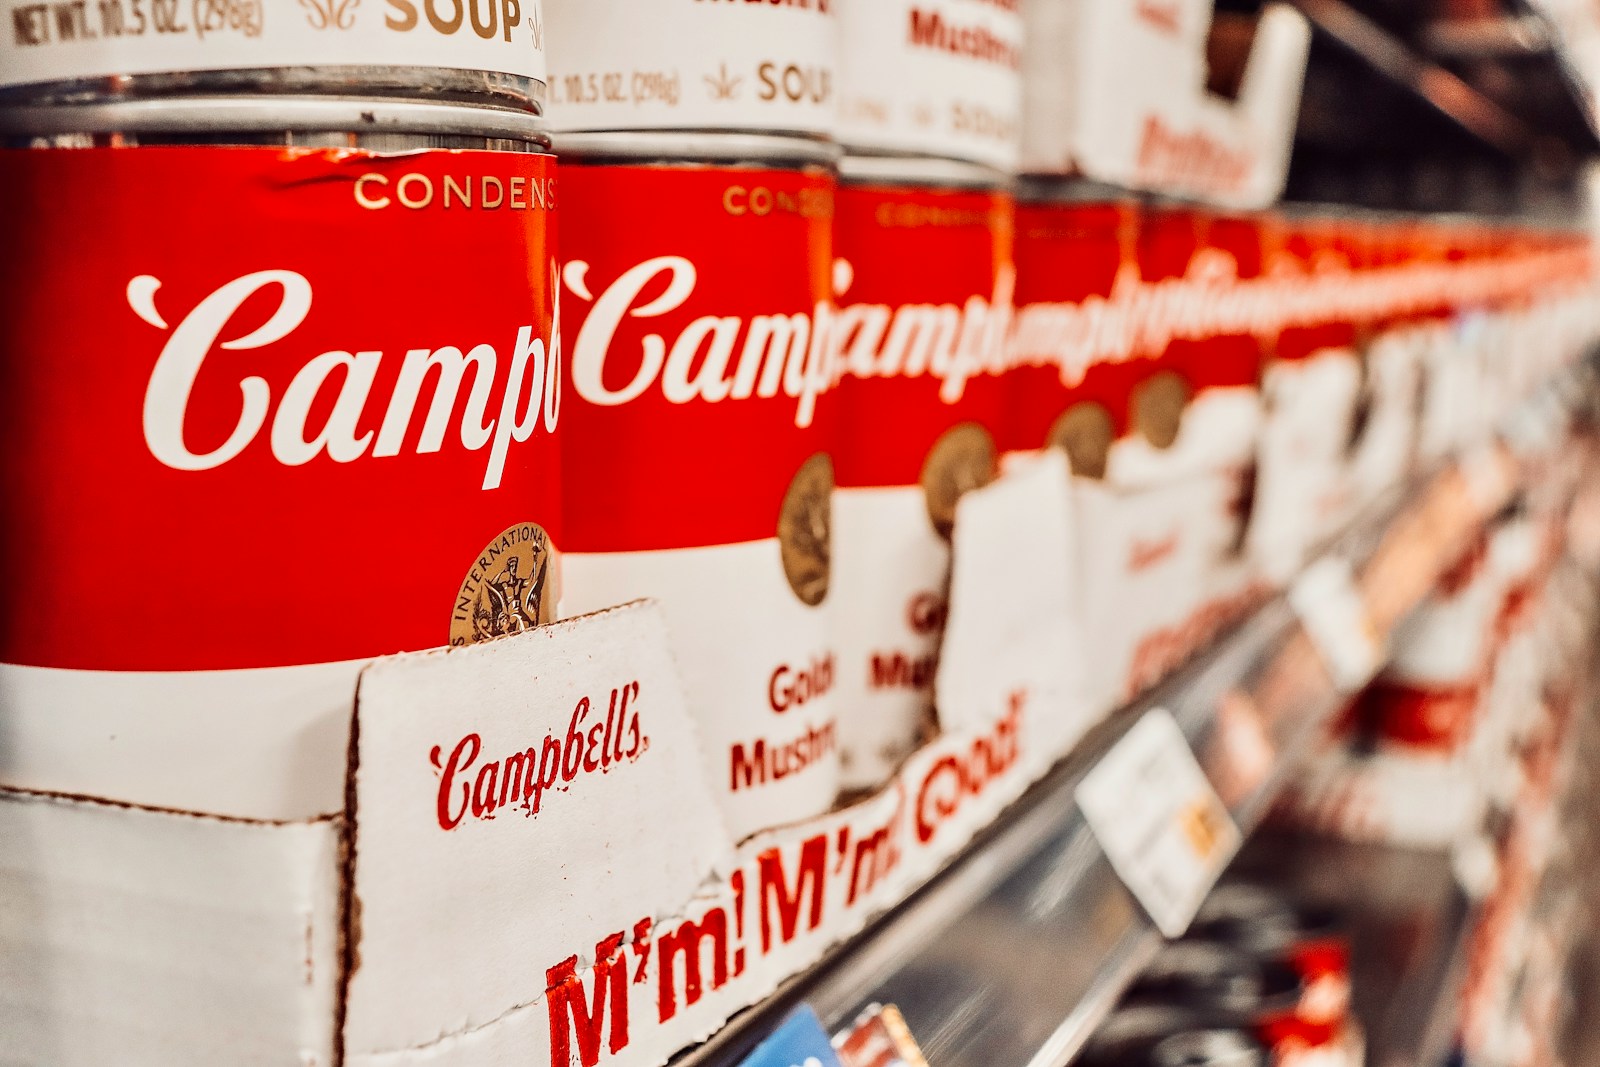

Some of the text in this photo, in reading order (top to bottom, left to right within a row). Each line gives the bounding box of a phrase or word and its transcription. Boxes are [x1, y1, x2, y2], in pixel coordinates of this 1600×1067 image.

[384, 0, 521, 43] SOUP
[454, 526, 548, 621] INTERNATIONAL
[429, 681, 649, 832] Campbell's
[545, 868, 746, 1067] M'm!
